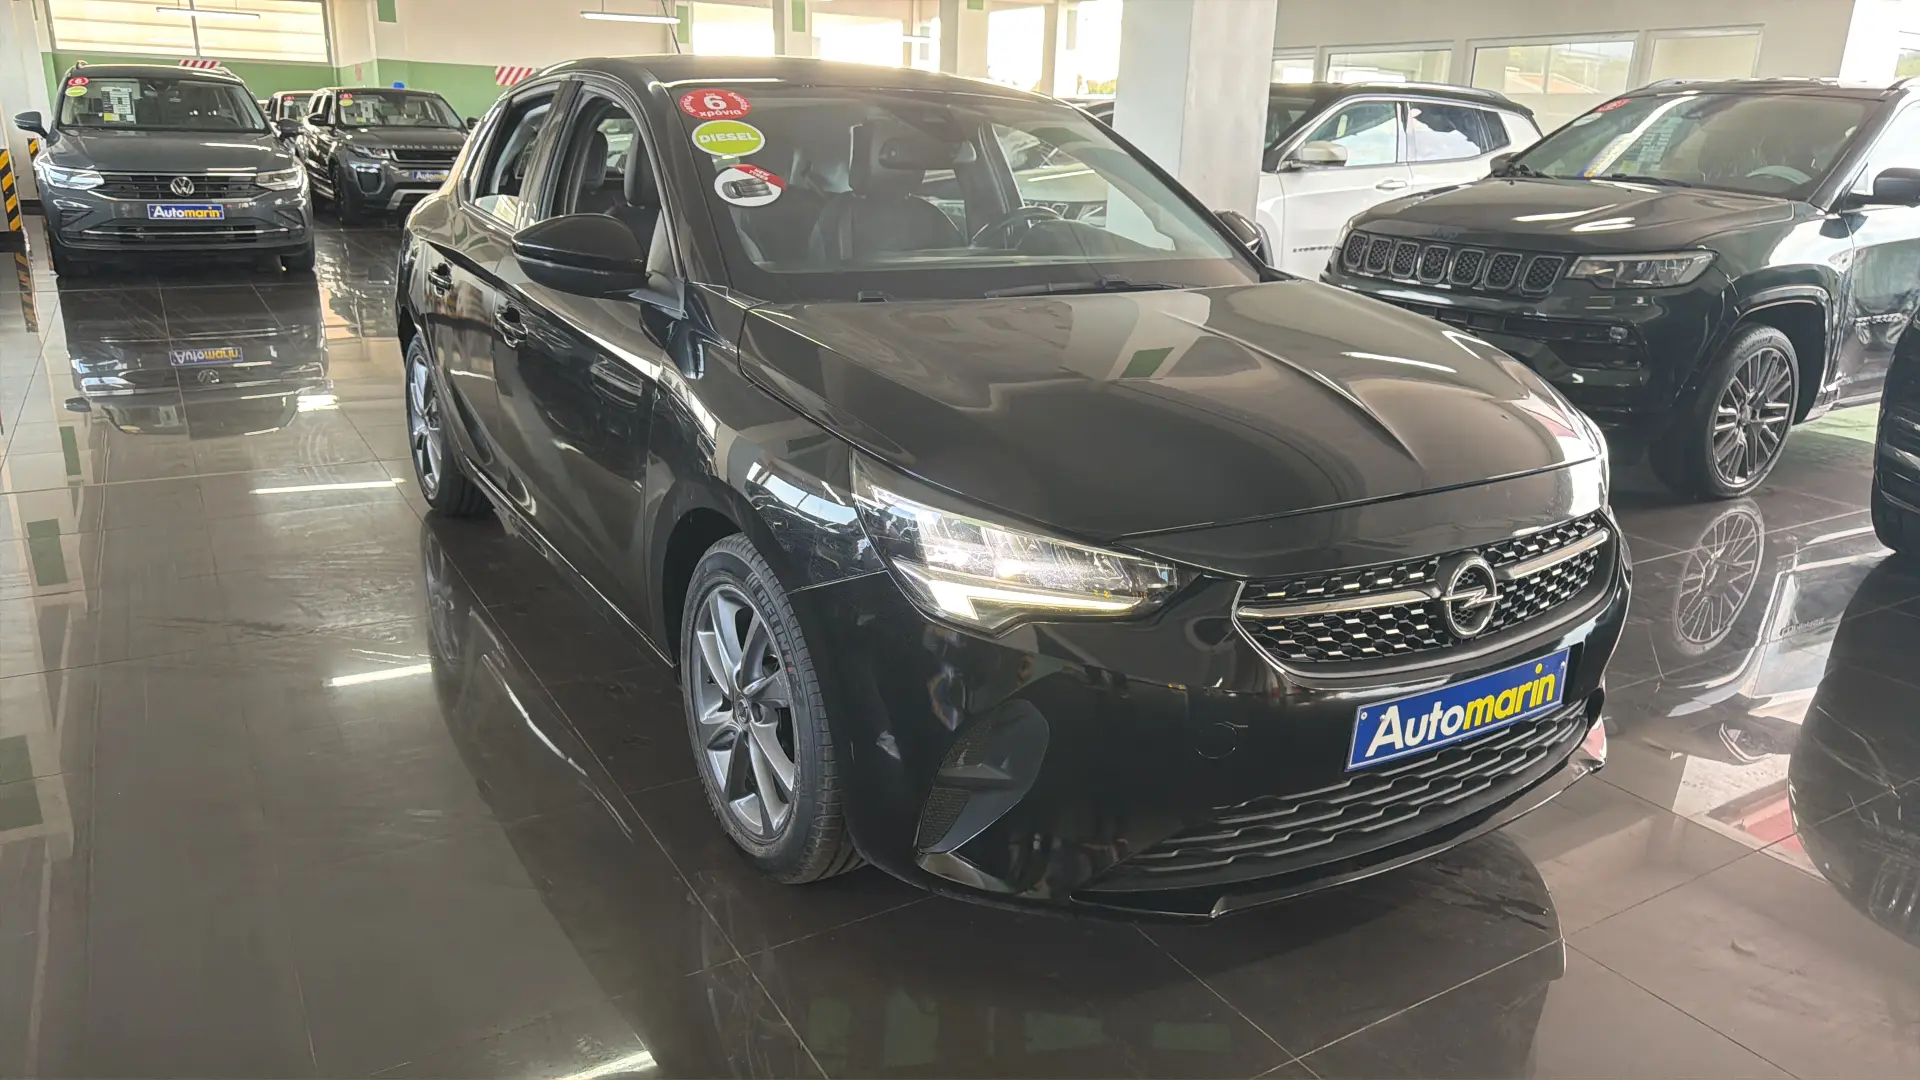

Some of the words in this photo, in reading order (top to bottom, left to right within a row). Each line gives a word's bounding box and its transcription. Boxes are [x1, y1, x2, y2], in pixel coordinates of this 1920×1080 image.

[703, 95, 727, 110] 6
[699, 109, 742, 117] χρόνια
[698, 132, 759, 144] DIESEL
[153, 205, 220, 217] Automarin
[1366, 664, 1556, 757] Automarin
